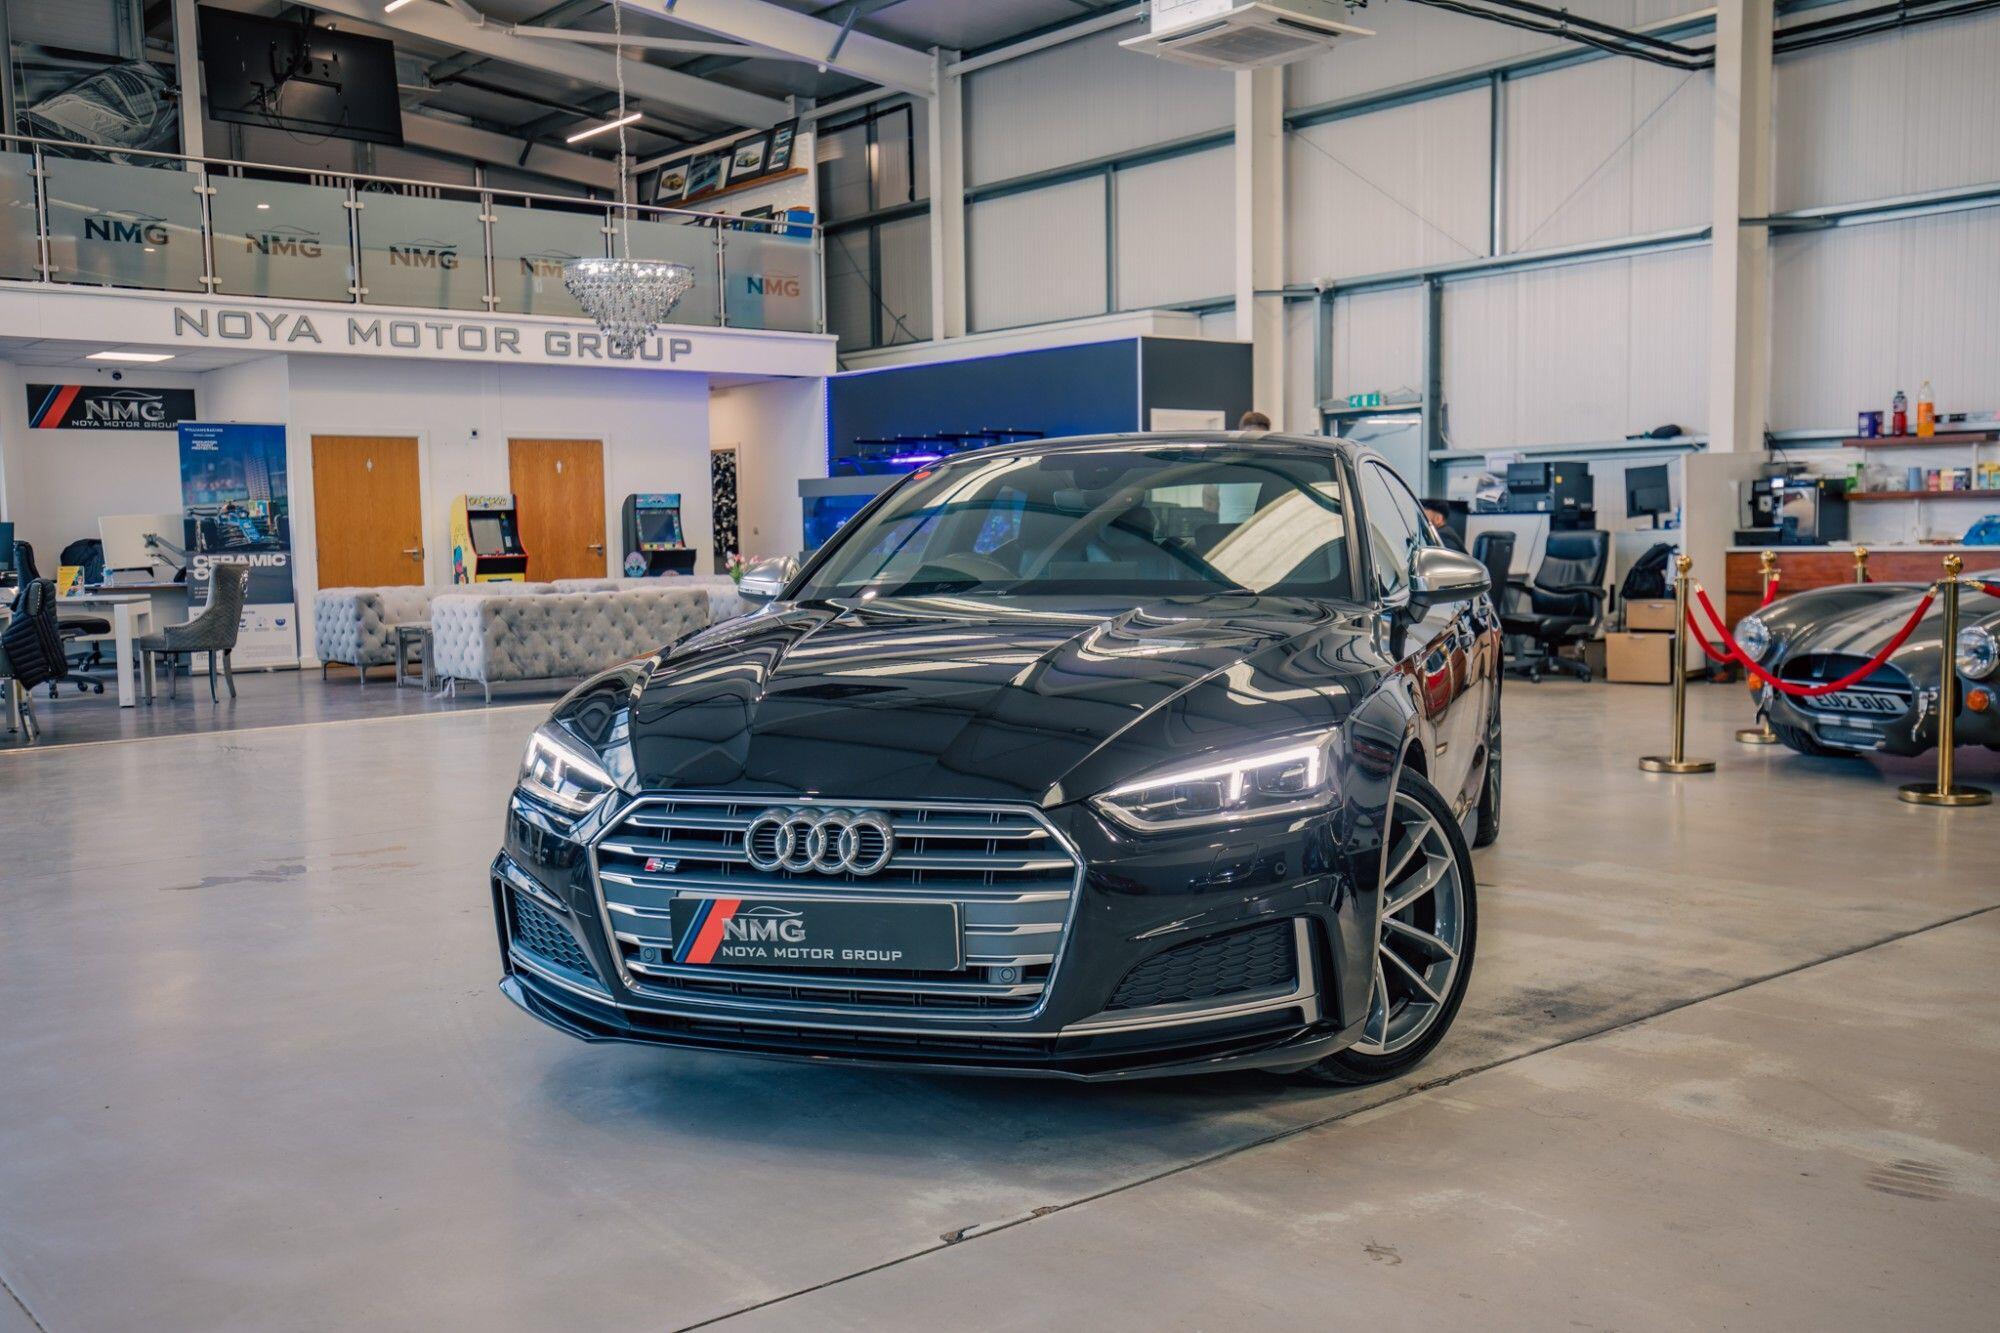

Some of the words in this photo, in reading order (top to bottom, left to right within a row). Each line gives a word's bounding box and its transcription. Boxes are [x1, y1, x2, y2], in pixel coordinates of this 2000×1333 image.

[84, 218, 169, 245] NMG
[246, 233, 322, 258] NMG
[389, 246, 459, 268] NMG
[520, 257, 563, 279] NM
[747, 276, 800, 298] NMG
[174, 306, 322, 344] NOYA
[347, 318, 521, 354] MOTOR
[84, 399, 166, 422] NMG
[103, 420, 141, 428] MOTOR
[192, 553, 287, 568] CERAMIC
[722, 918, 806, 942] NMG
[722, 946, 767, 958] NOYA
[774, 947, 834, 960] MOTOR
[842, 949, 902, 961] GROUP
